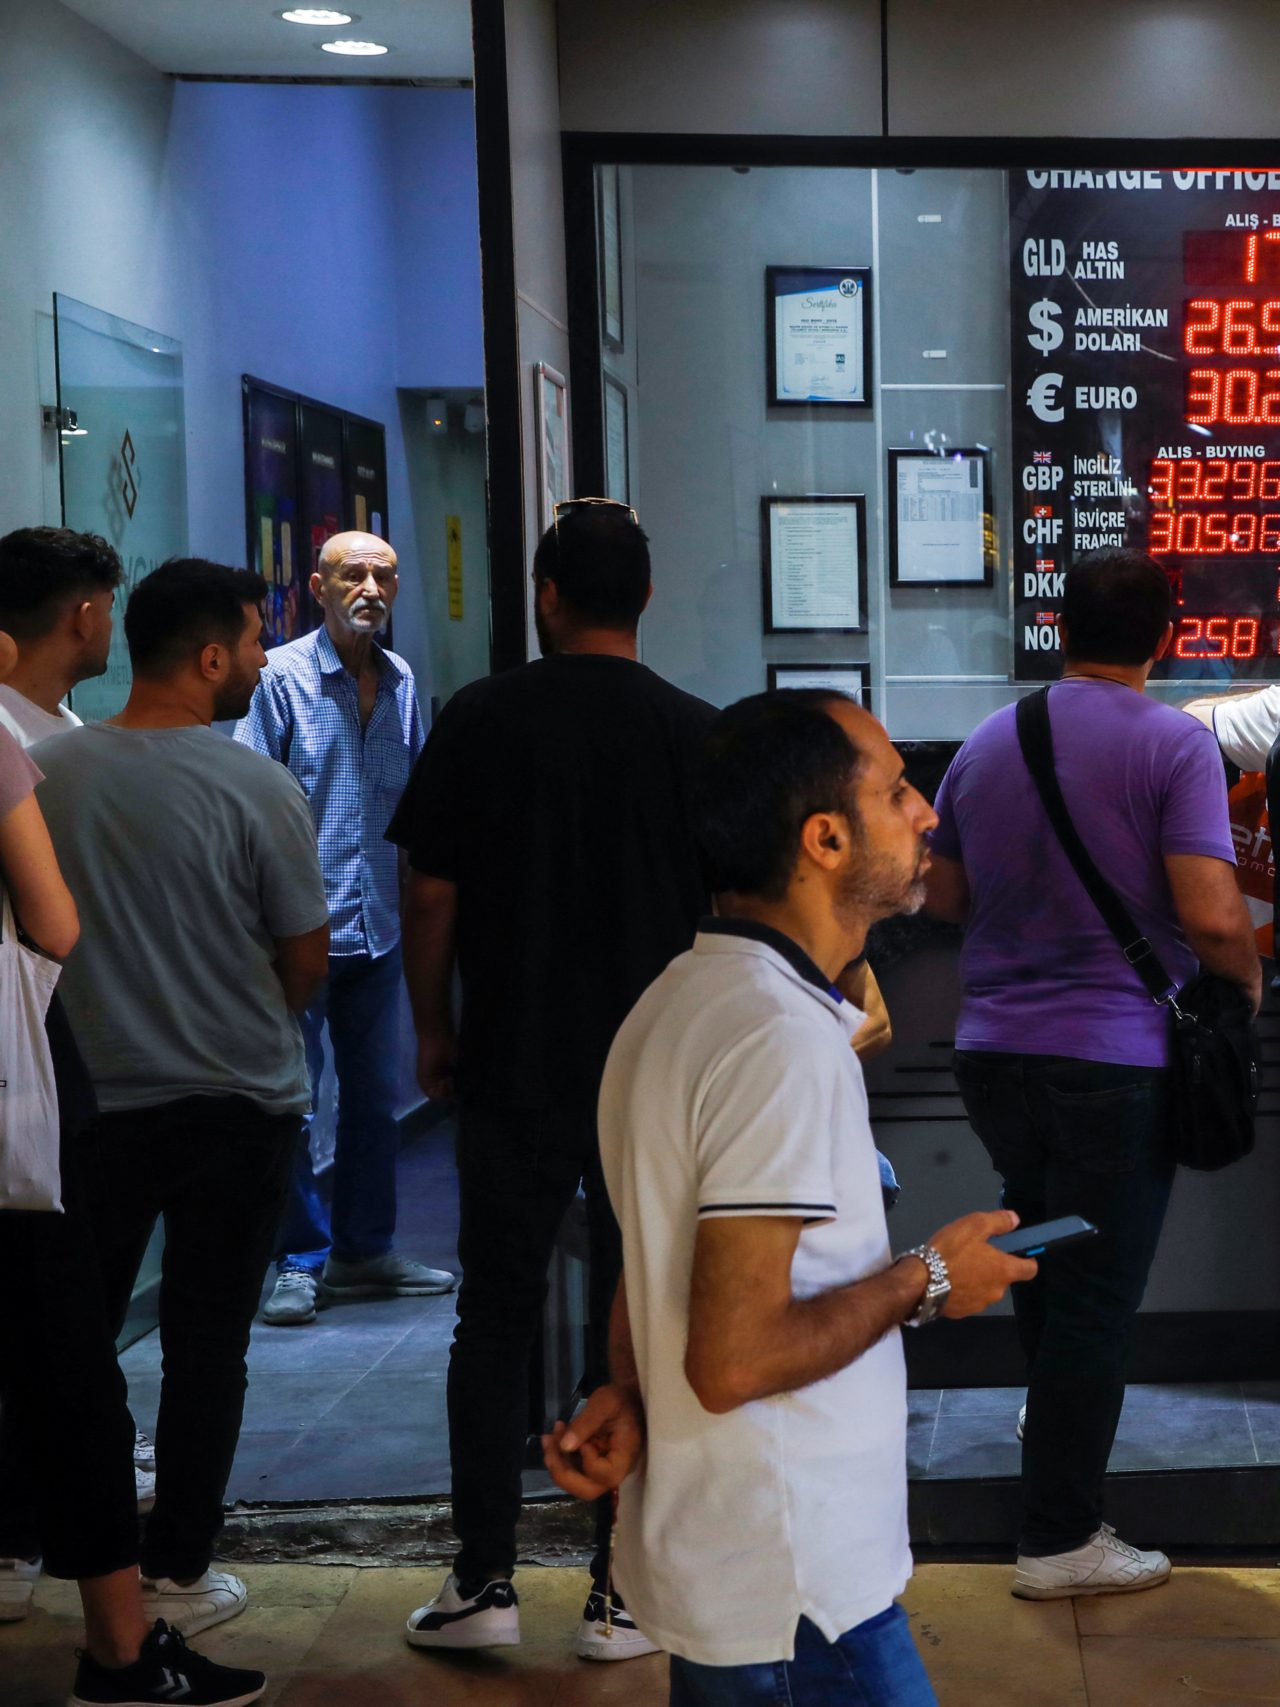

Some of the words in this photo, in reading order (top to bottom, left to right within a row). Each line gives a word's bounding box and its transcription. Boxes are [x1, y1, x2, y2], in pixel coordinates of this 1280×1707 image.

[1225, 214, 1259, 230] ALIŞ
[1023, 238, 1066, 276] GLD
[1083, 241, 1119, 260] HAS
[1074, 261, 1125, 280] ALTIN
[1075, 304, 1168, 327] AMERİKAN
[1027, 298, 1065, 357] $
[1075, 333, 1141, 351] DOLARI
[1026, 373, 1065, 422] €
[1075, 386, 1138, 409] EURO
[1206, 446, 1266, 458] BUYING
[1074, 455, 1122, 475] İNGİLİZ
[1022, 466, 1063, 491] GBP
[1074, 477, 1132, 497] STERLİNİ
[1074, 508, 1126, 531] İSVİÇRE
[1023, 519, 1063, 544] CHF
[1024, 572, 1066, 597] DKK
